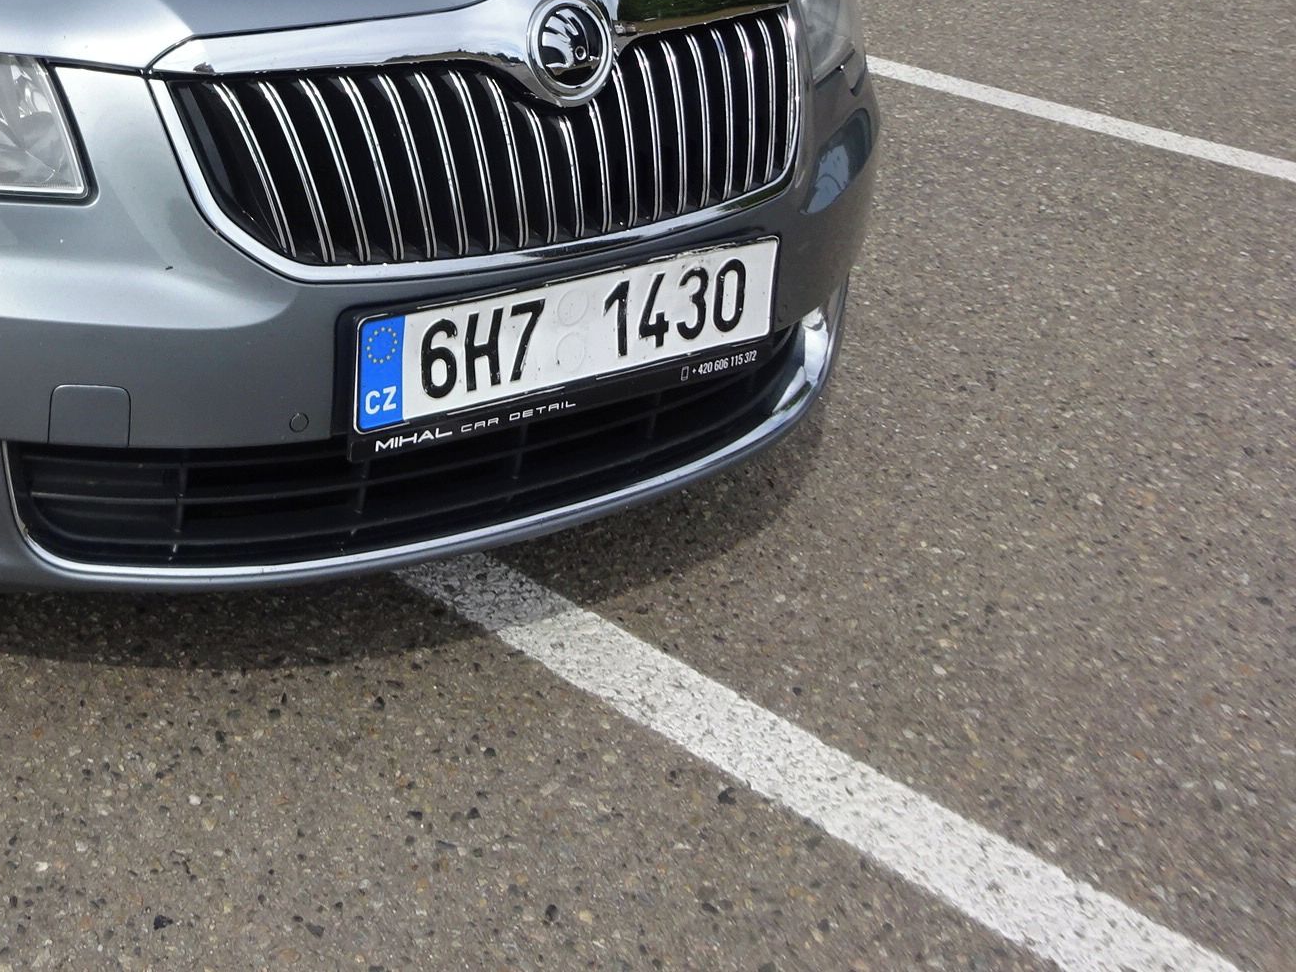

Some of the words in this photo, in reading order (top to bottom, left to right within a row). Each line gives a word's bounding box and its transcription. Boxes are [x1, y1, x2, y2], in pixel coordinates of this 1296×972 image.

[419, 298, 546, 400] 6H7
[603, 257, 748, 358] 1430
[714, 357, 729, 371] 606
[730, 353, 744, 367] 115
[744, 349, 758, 364] 372
[364, 385, 398, 416] CZ
[375, 427, 453, 453] MIHAL
[460, 416, 500, 433] CAR
[508, 400, 577, 422] DETAIL
